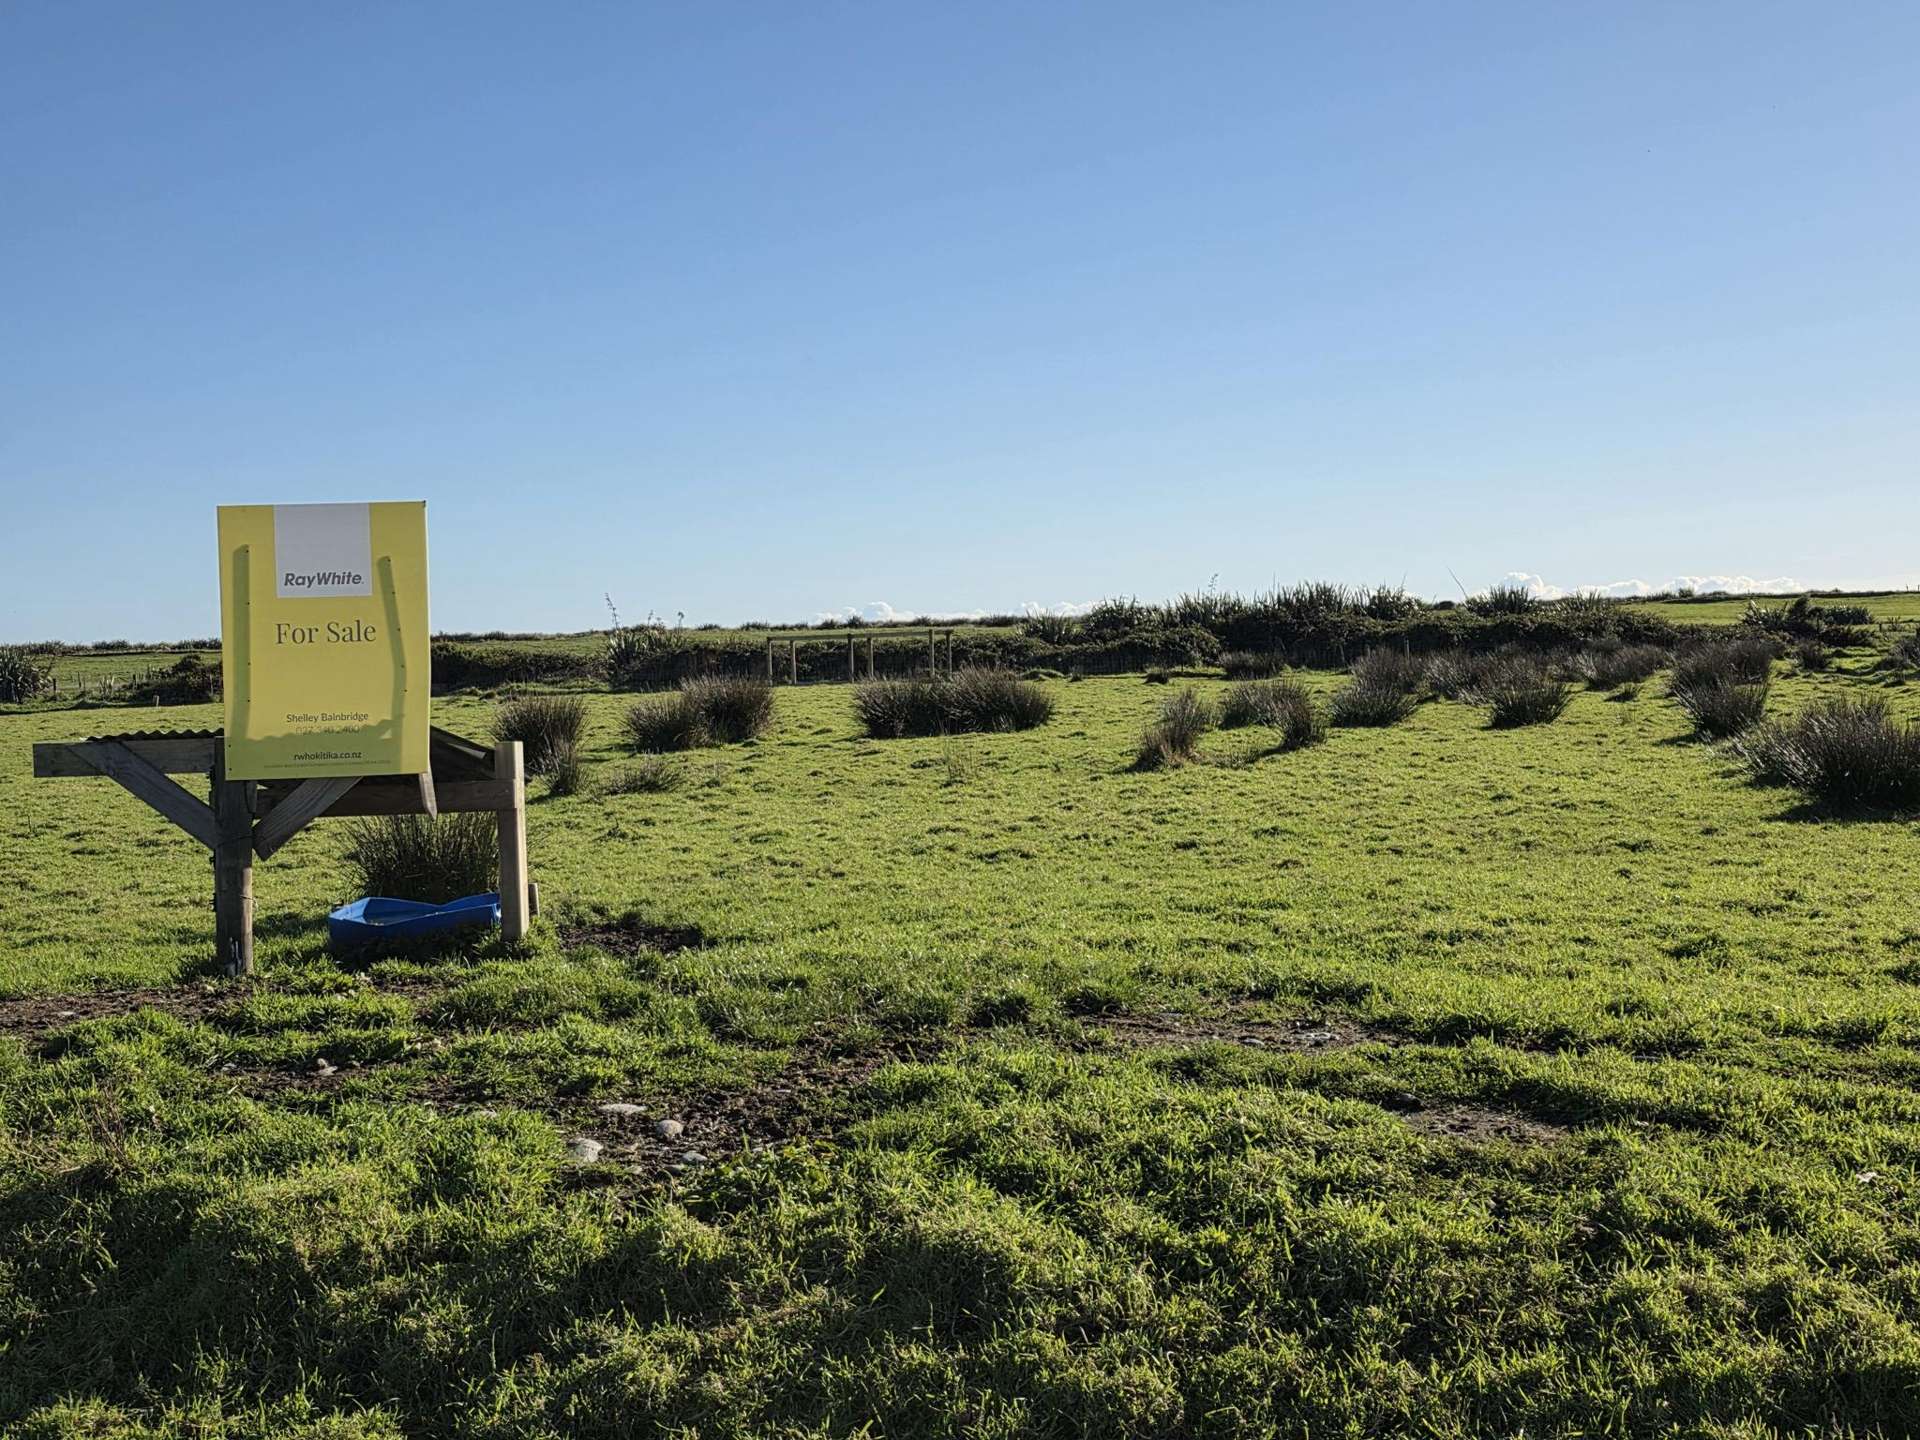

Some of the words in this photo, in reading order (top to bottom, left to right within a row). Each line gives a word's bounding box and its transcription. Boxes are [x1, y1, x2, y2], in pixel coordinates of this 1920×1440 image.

[276, 622, 319, 644] For
[326, 619, 377, 642] Sale
[286, 713, 319, 723] Shelley
[321, 711, 368, 722] Bainbridge
[293, 750, 362, 761] rwhokitika.co.nz
